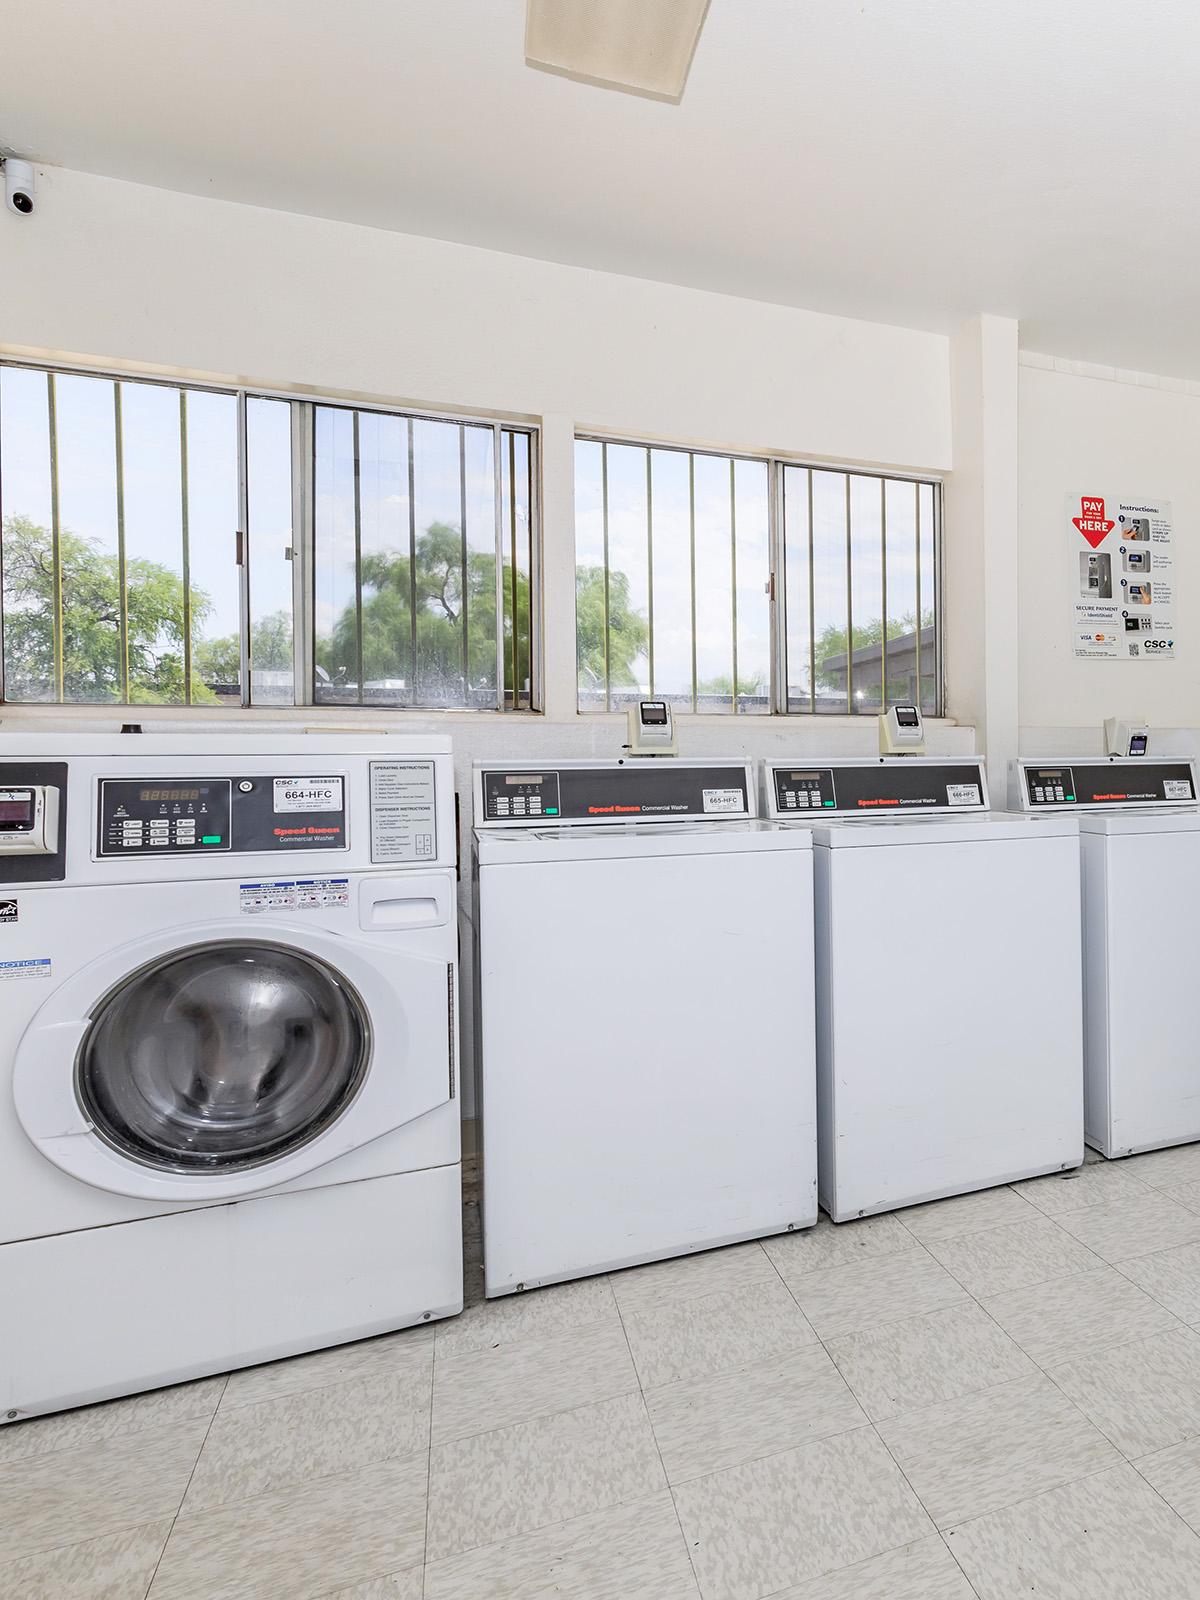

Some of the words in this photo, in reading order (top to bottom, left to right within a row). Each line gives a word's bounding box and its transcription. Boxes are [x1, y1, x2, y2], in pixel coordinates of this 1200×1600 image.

[1083, 501, 1102, 511] PAY
[1119, 504, 1160, 513] Instructions:
[1080, 520, 1109, 532] HERE
[1144, 640, 1166, 648] CSC
[285, 790, 332, 799] 664-HFC
[273, 827, 306, 836] Speed
[0, 960, 42, 968] NOTICE
